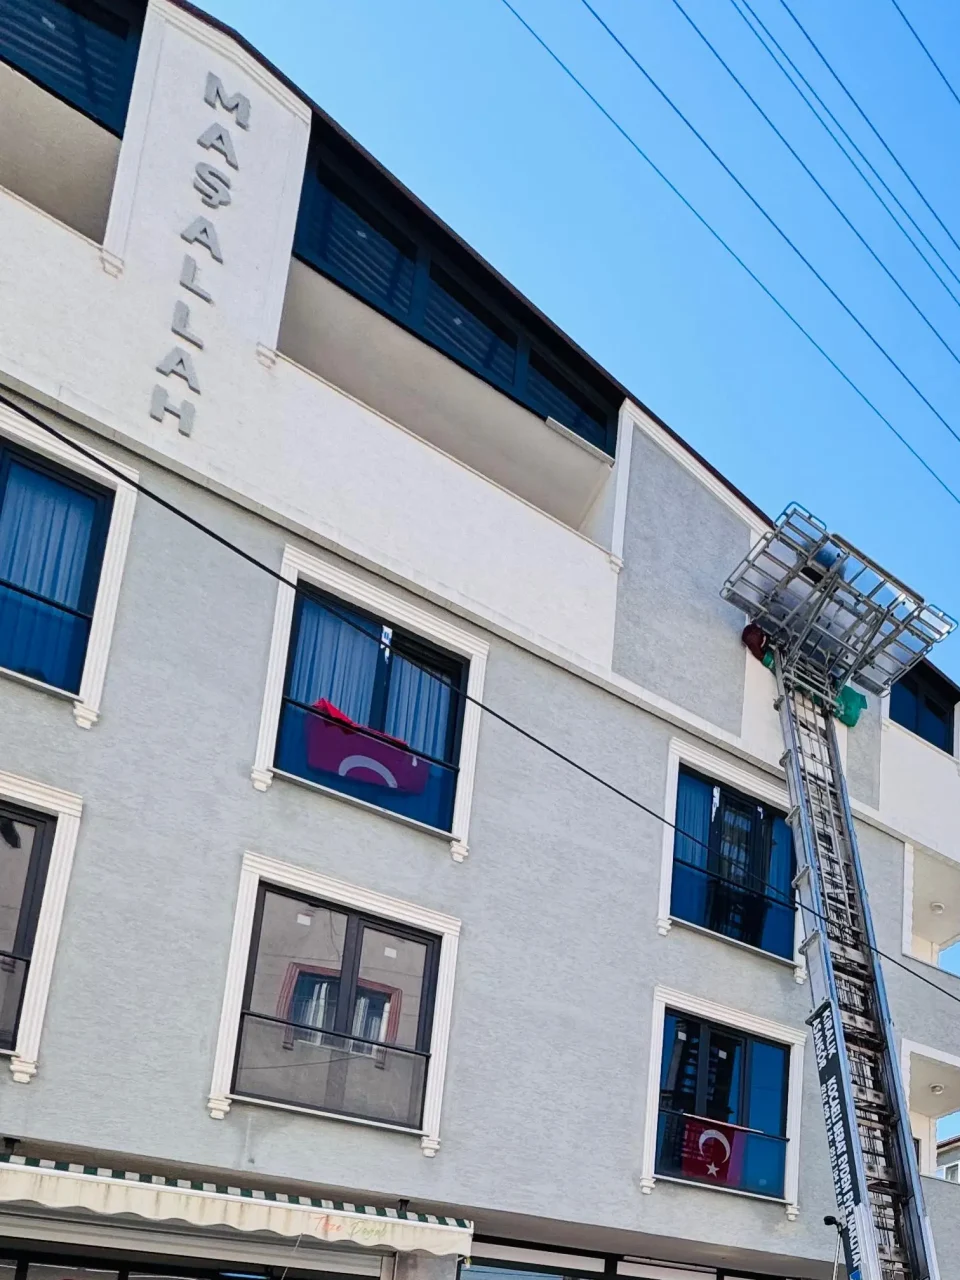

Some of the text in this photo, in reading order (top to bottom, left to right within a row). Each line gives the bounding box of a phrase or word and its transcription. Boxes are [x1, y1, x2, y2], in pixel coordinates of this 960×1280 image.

[150, 71, 251, 438] MAŞALLAH
[833, 1120, 847, 1155] BERAT
[838, 1154, 852, 1194] EVDEN
